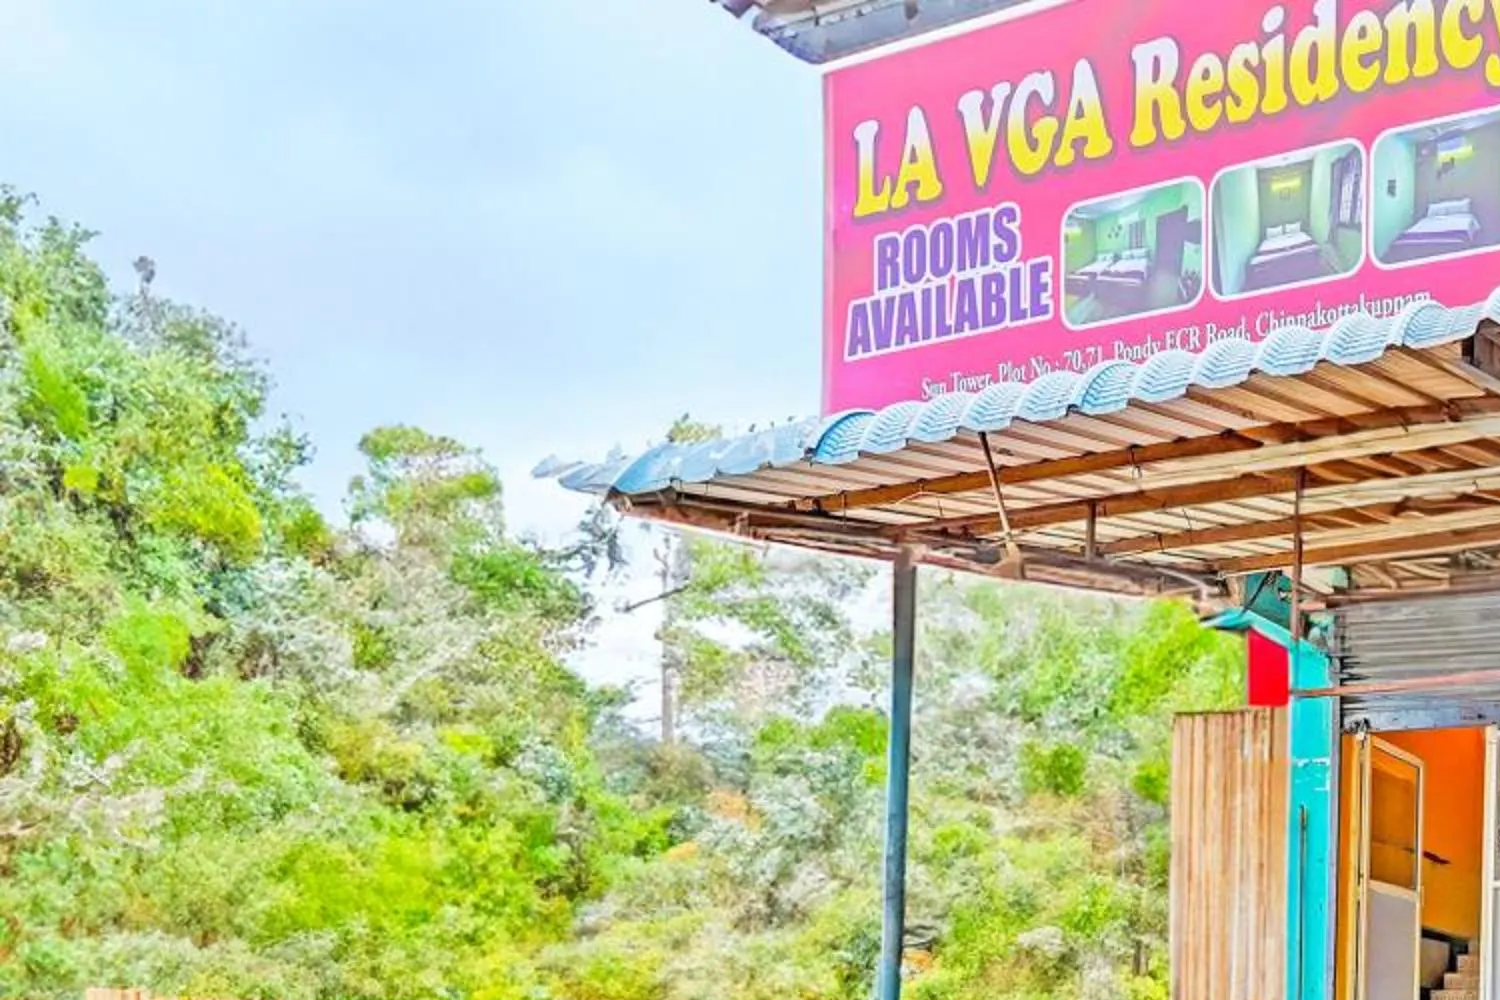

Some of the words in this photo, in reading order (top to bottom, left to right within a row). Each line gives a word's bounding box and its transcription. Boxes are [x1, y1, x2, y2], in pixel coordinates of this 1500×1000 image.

[853, 105, 943, 217] LA
[958, 57, 1113, 188] VGA
[876, 205, 1019, 292] ROOMS
[847, 260, 1051, 358] AVAILABLE
[998, 361, 1027, 383] Plot
[1114, 334, 1161, 362] Pondy
[1165, 325, 1201, 351] ECR
